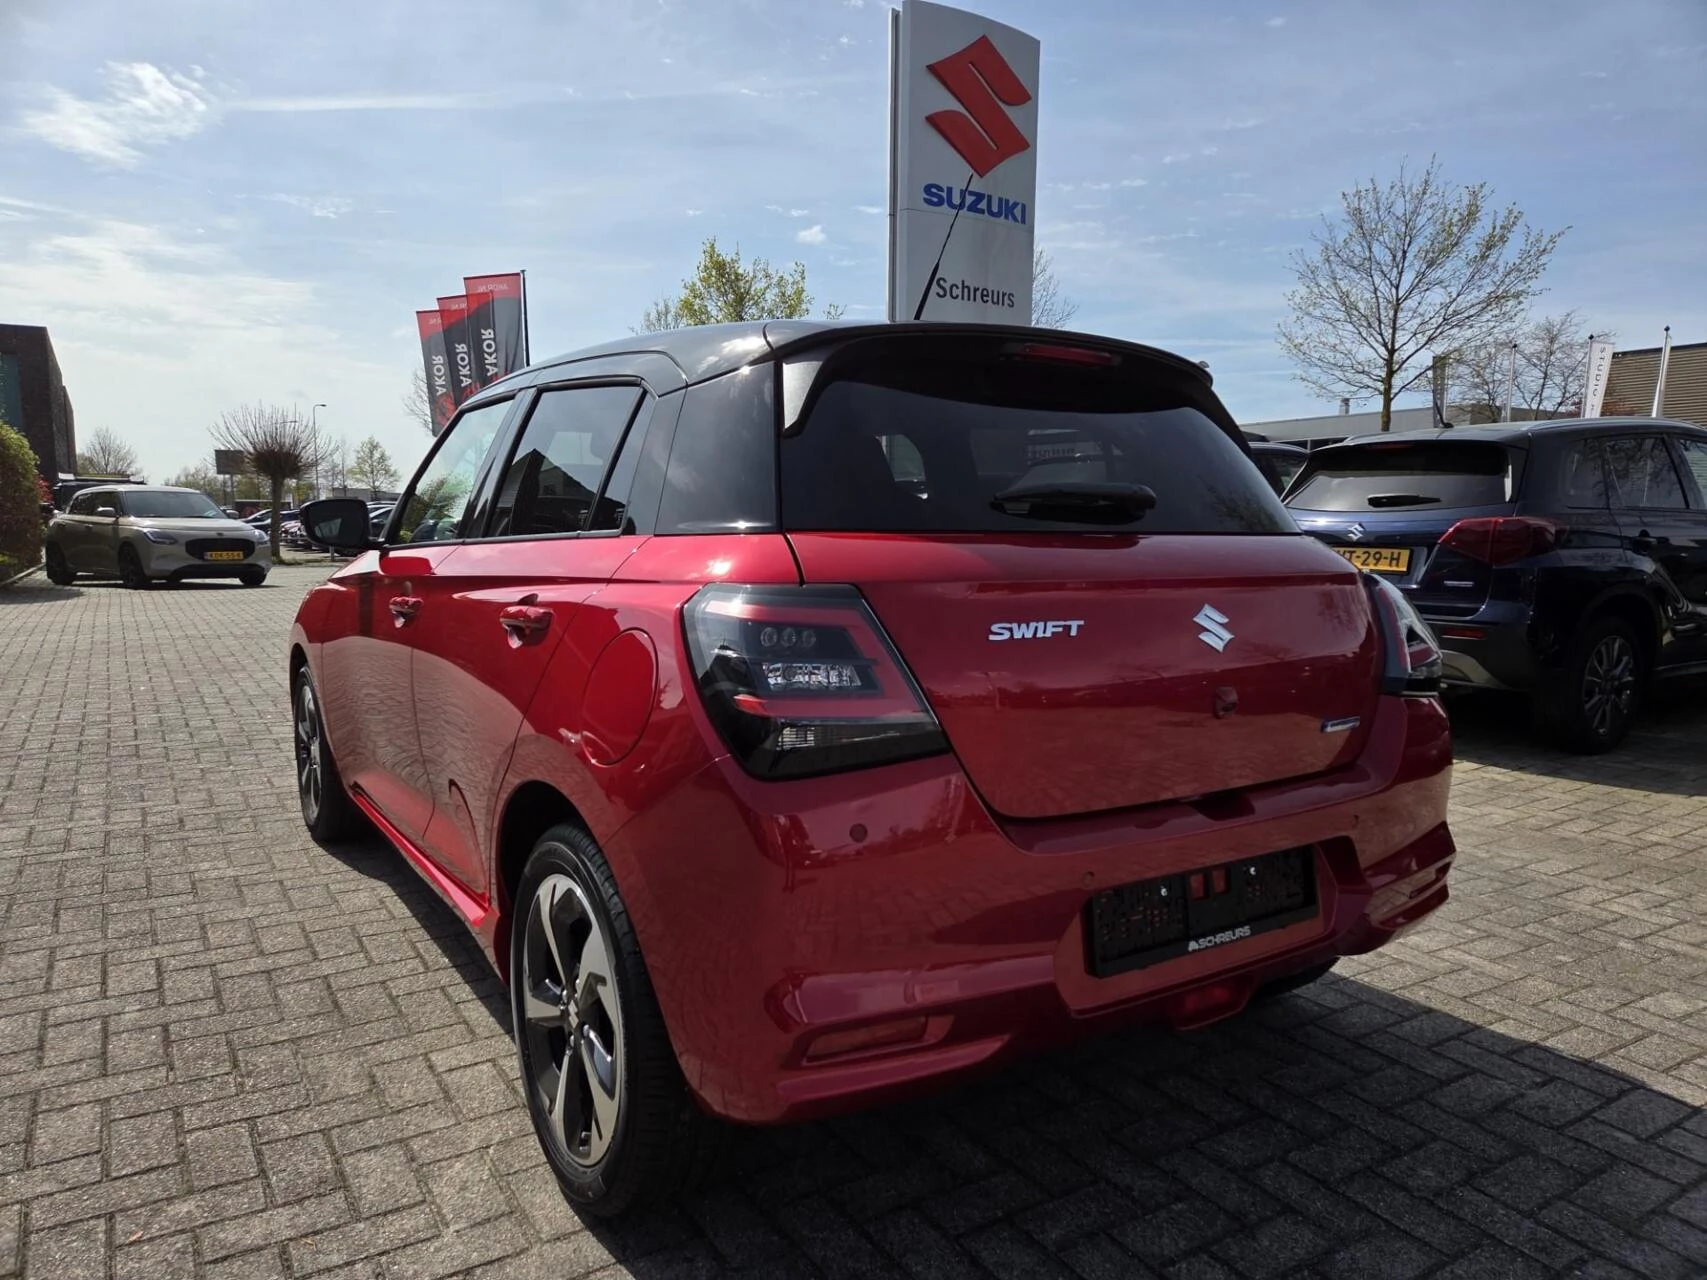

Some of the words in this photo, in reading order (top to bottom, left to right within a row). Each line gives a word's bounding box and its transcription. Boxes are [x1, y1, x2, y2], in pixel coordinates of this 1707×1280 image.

[922, 183, 1027, 225] SUZUKI
[935, 277, 1015, 309] Schreurs
[988, 620, 1084, 641] SWIFT
